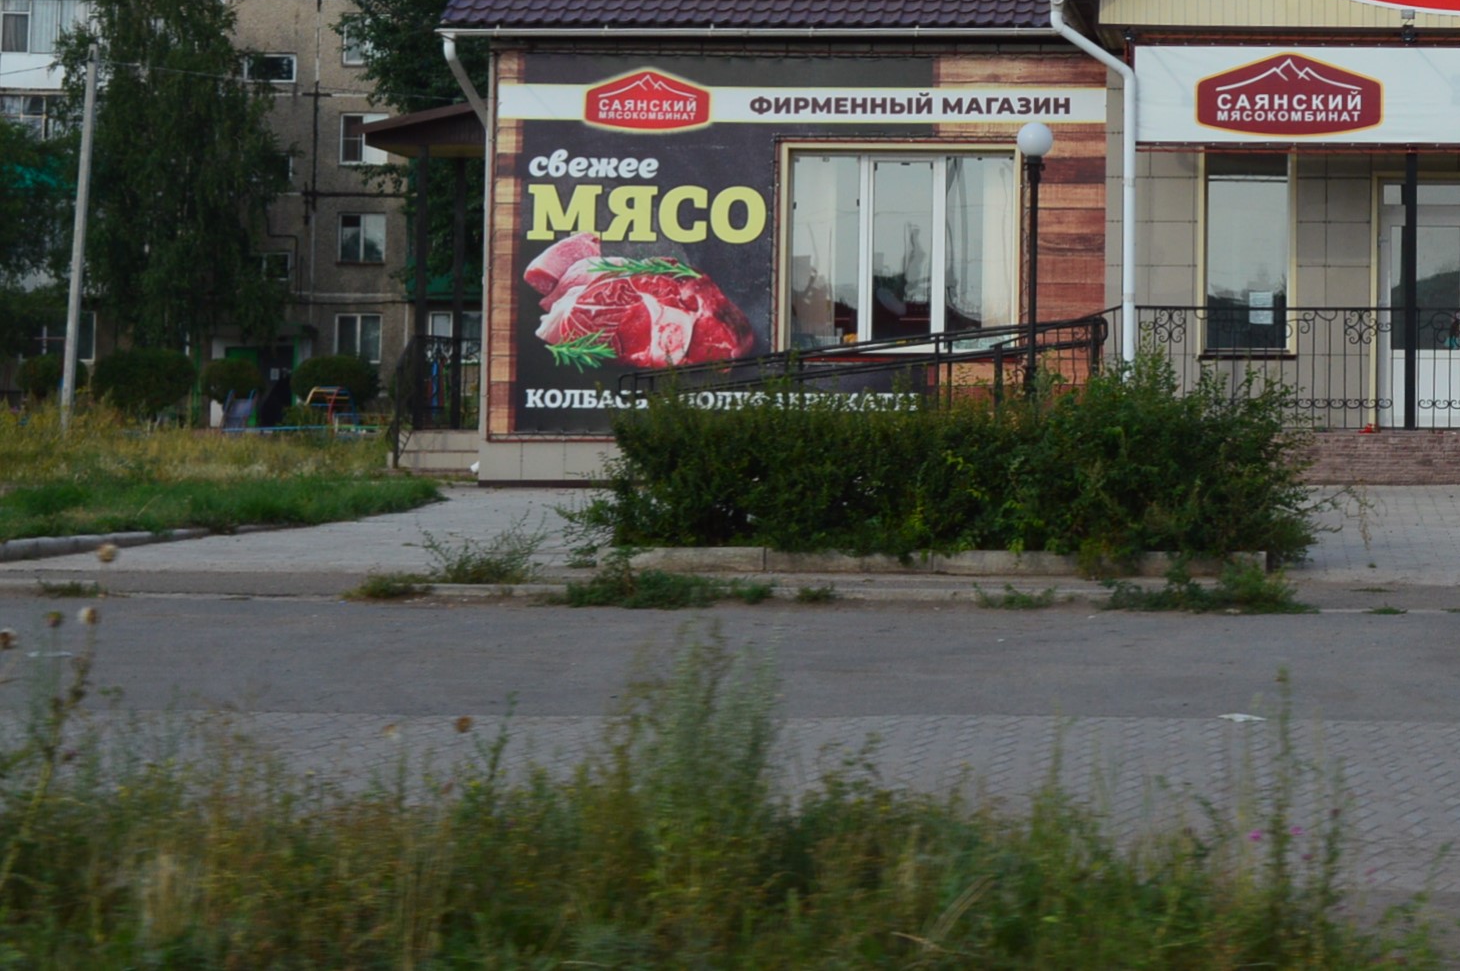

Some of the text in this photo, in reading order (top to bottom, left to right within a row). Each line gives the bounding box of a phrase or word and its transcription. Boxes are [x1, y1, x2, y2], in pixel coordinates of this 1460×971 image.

[599, 98, 697, 112] САЯНСКИЙ
[749, 92, 1071, 115] ФИРМЕННЫЙ МАГАЗИН
[1217, 90, 1362, 110] САЯНСКИЙ
[598, 111, 696, 121] МЯСОКОМБИНАТ
[1216, 110, 1361, 122] МЯСОКОМБИНАТ
[528, 149, 660, 179] свежее
[526, 184, 767, 244] МЯСО
